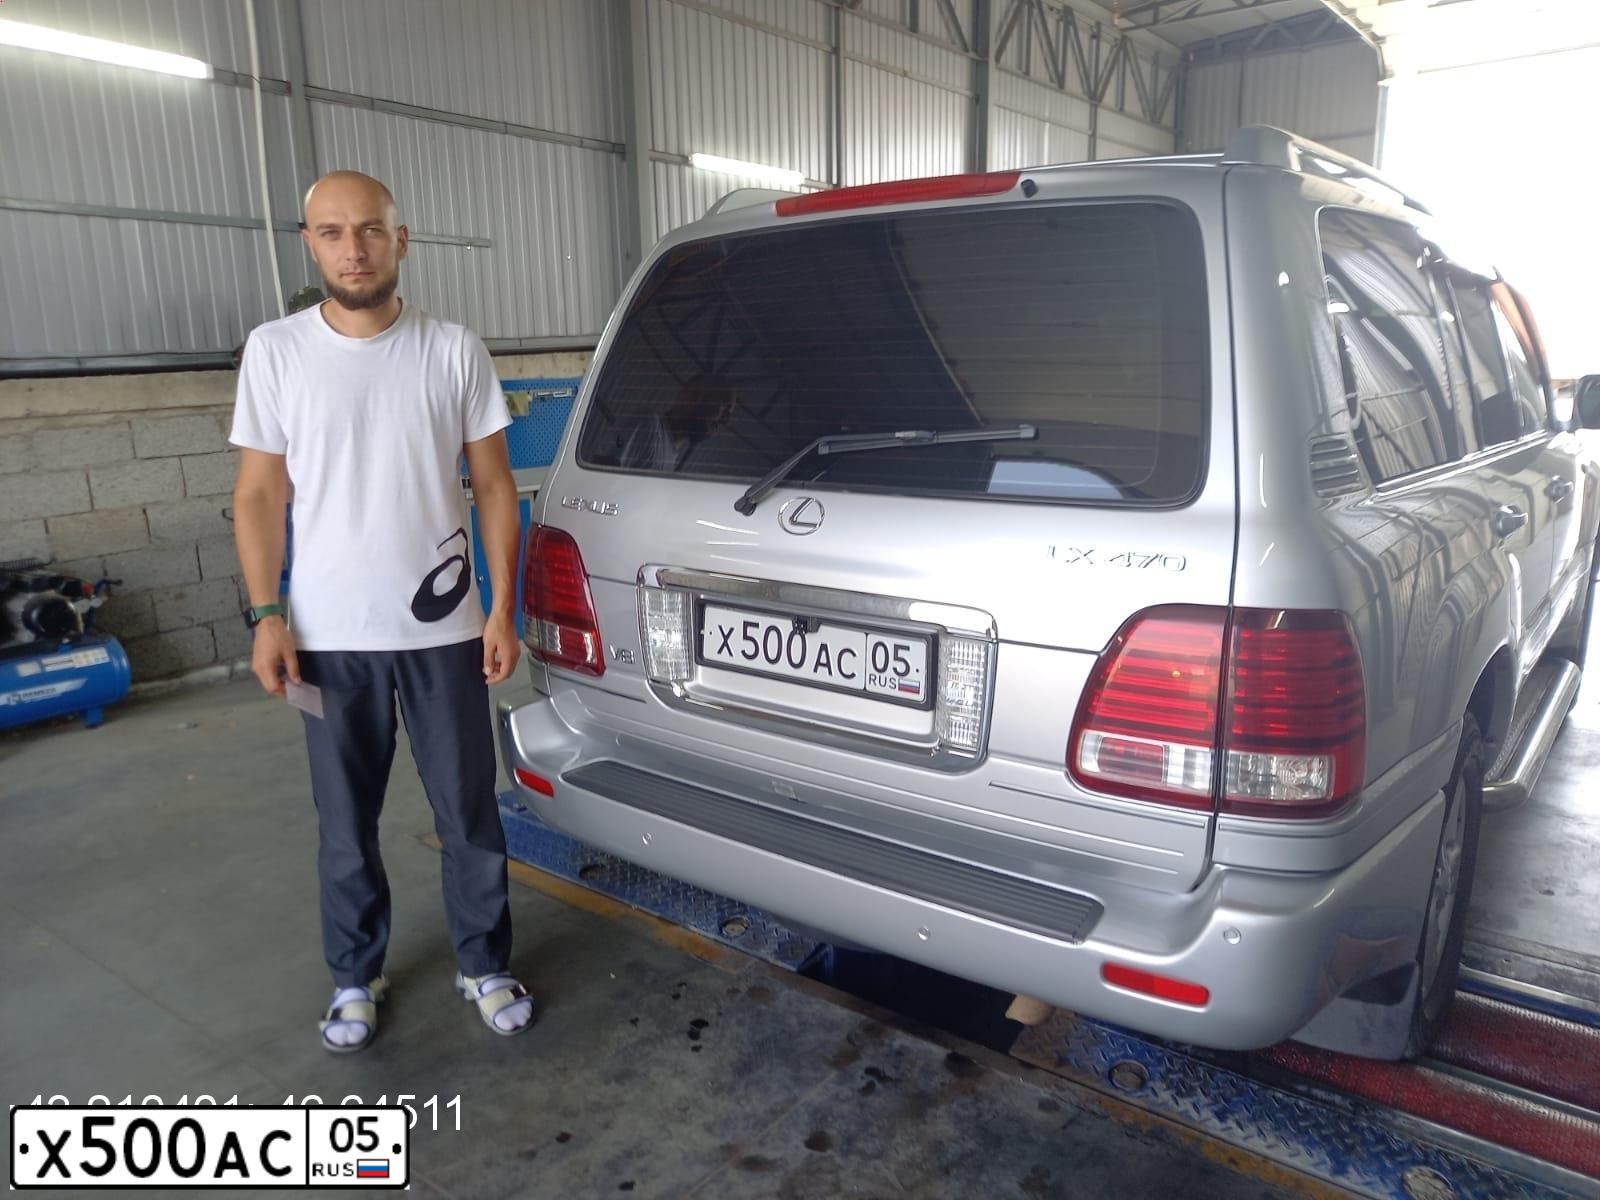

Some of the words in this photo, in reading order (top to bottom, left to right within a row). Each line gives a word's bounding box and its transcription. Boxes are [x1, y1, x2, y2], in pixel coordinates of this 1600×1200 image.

[561, 496, 618, 516] LEXUS
[1104, 551, 1187, 573] 470
[871, 641, 911, 676] 05
[868, 673, 897, 690] RUS
